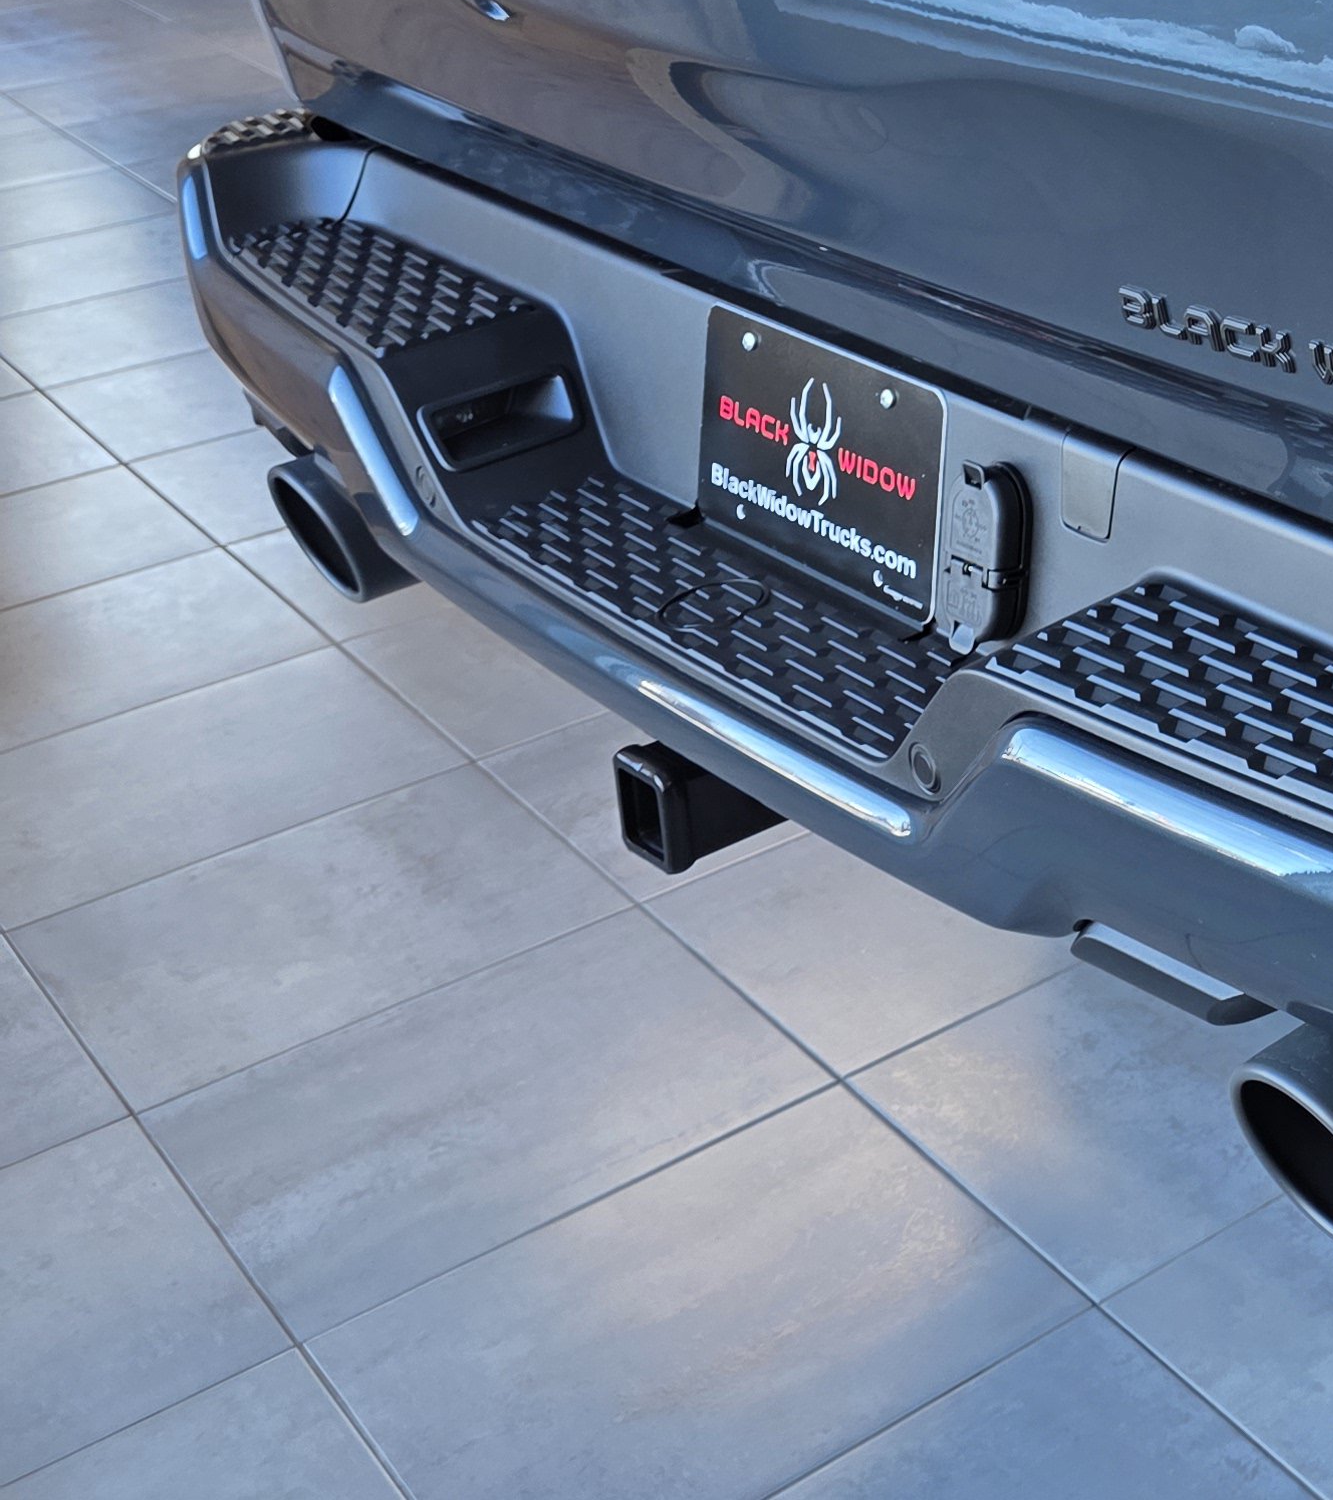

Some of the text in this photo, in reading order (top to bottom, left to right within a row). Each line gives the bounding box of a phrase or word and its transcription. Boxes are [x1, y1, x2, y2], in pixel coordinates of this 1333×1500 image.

[1119, 284, 1298, 374] BLACK
[719, 395, 916, 501] BLACK WIDOW
[711, 462, 917, 579] BlackWidowTrucks.com
